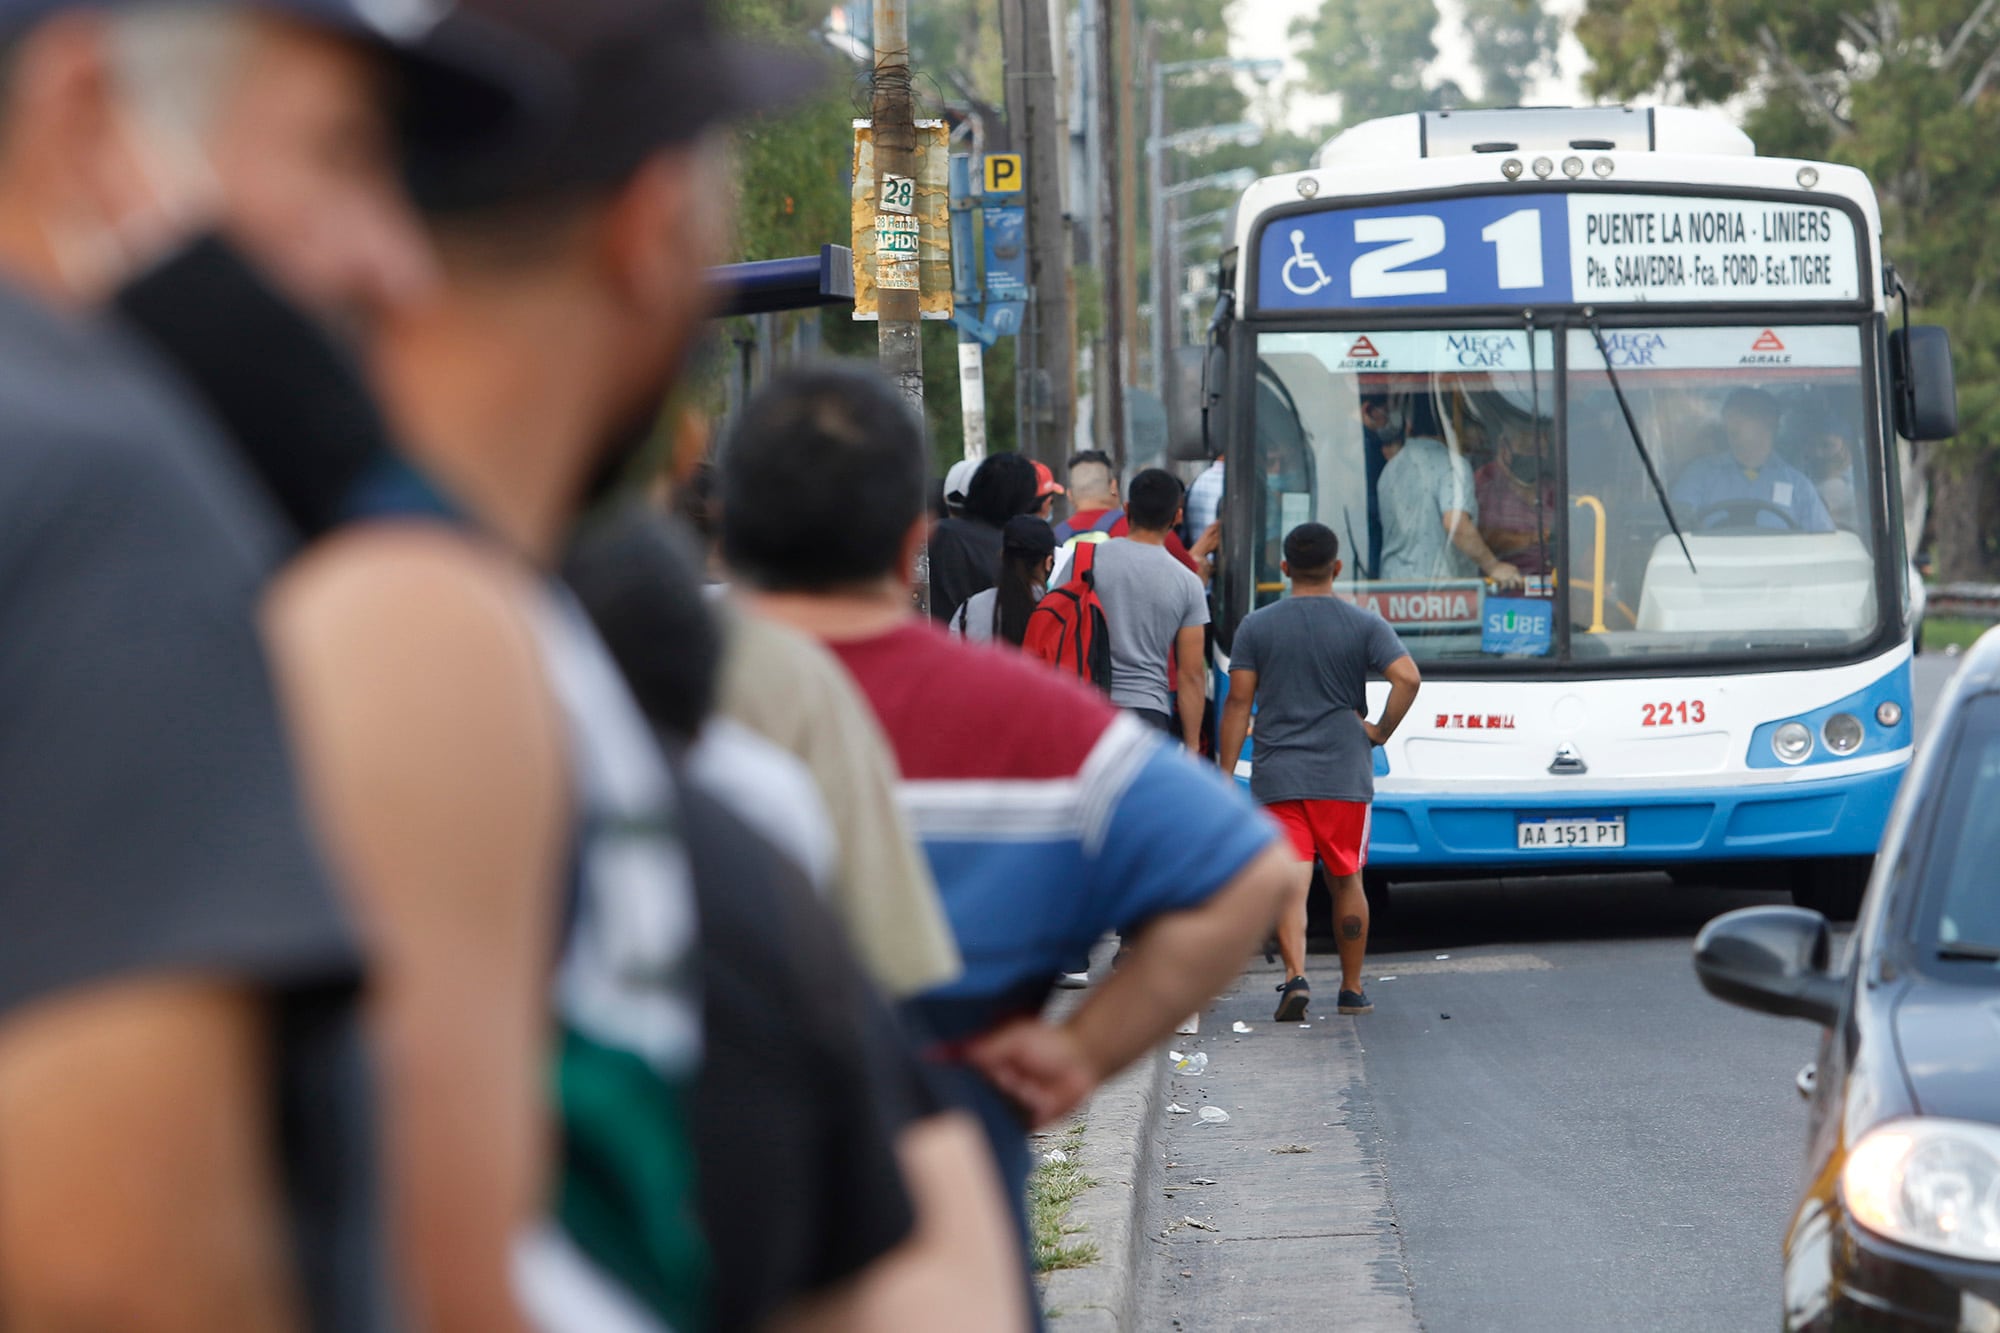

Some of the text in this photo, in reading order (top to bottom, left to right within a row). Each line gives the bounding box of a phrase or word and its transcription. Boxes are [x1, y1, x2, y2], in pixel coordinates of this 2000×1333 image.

[992, 159, 1015, 188] P
[884, 179, 911, 207] 28
[1587, 213, 1655, 244] PUENTE
[1662, 213, 1683, 243] LA
[1689, 212, 1746, 243] NORIA
[1763, 210, 1831, 242] LINIERS
[1350, 208, 1544, 298] 21
[1587, 256, 1611, 287] Pte.
[1615, 256, 1685, 287] SAAVEDRA
[1446, 334, 1516, 352] MEGA
[1596, 333, 1666, 351] MEGA
[1457, 351, 1503, 367] CAR
[1606, 349, 1656, 366] CAR
[1389, 595, 1469, 620] NORIA
[1489, 610, 1545, 635] SUBE
[1642, 700, 1706, 726] 2213
[1523, 825, 1619, 845] AA 151 PT
